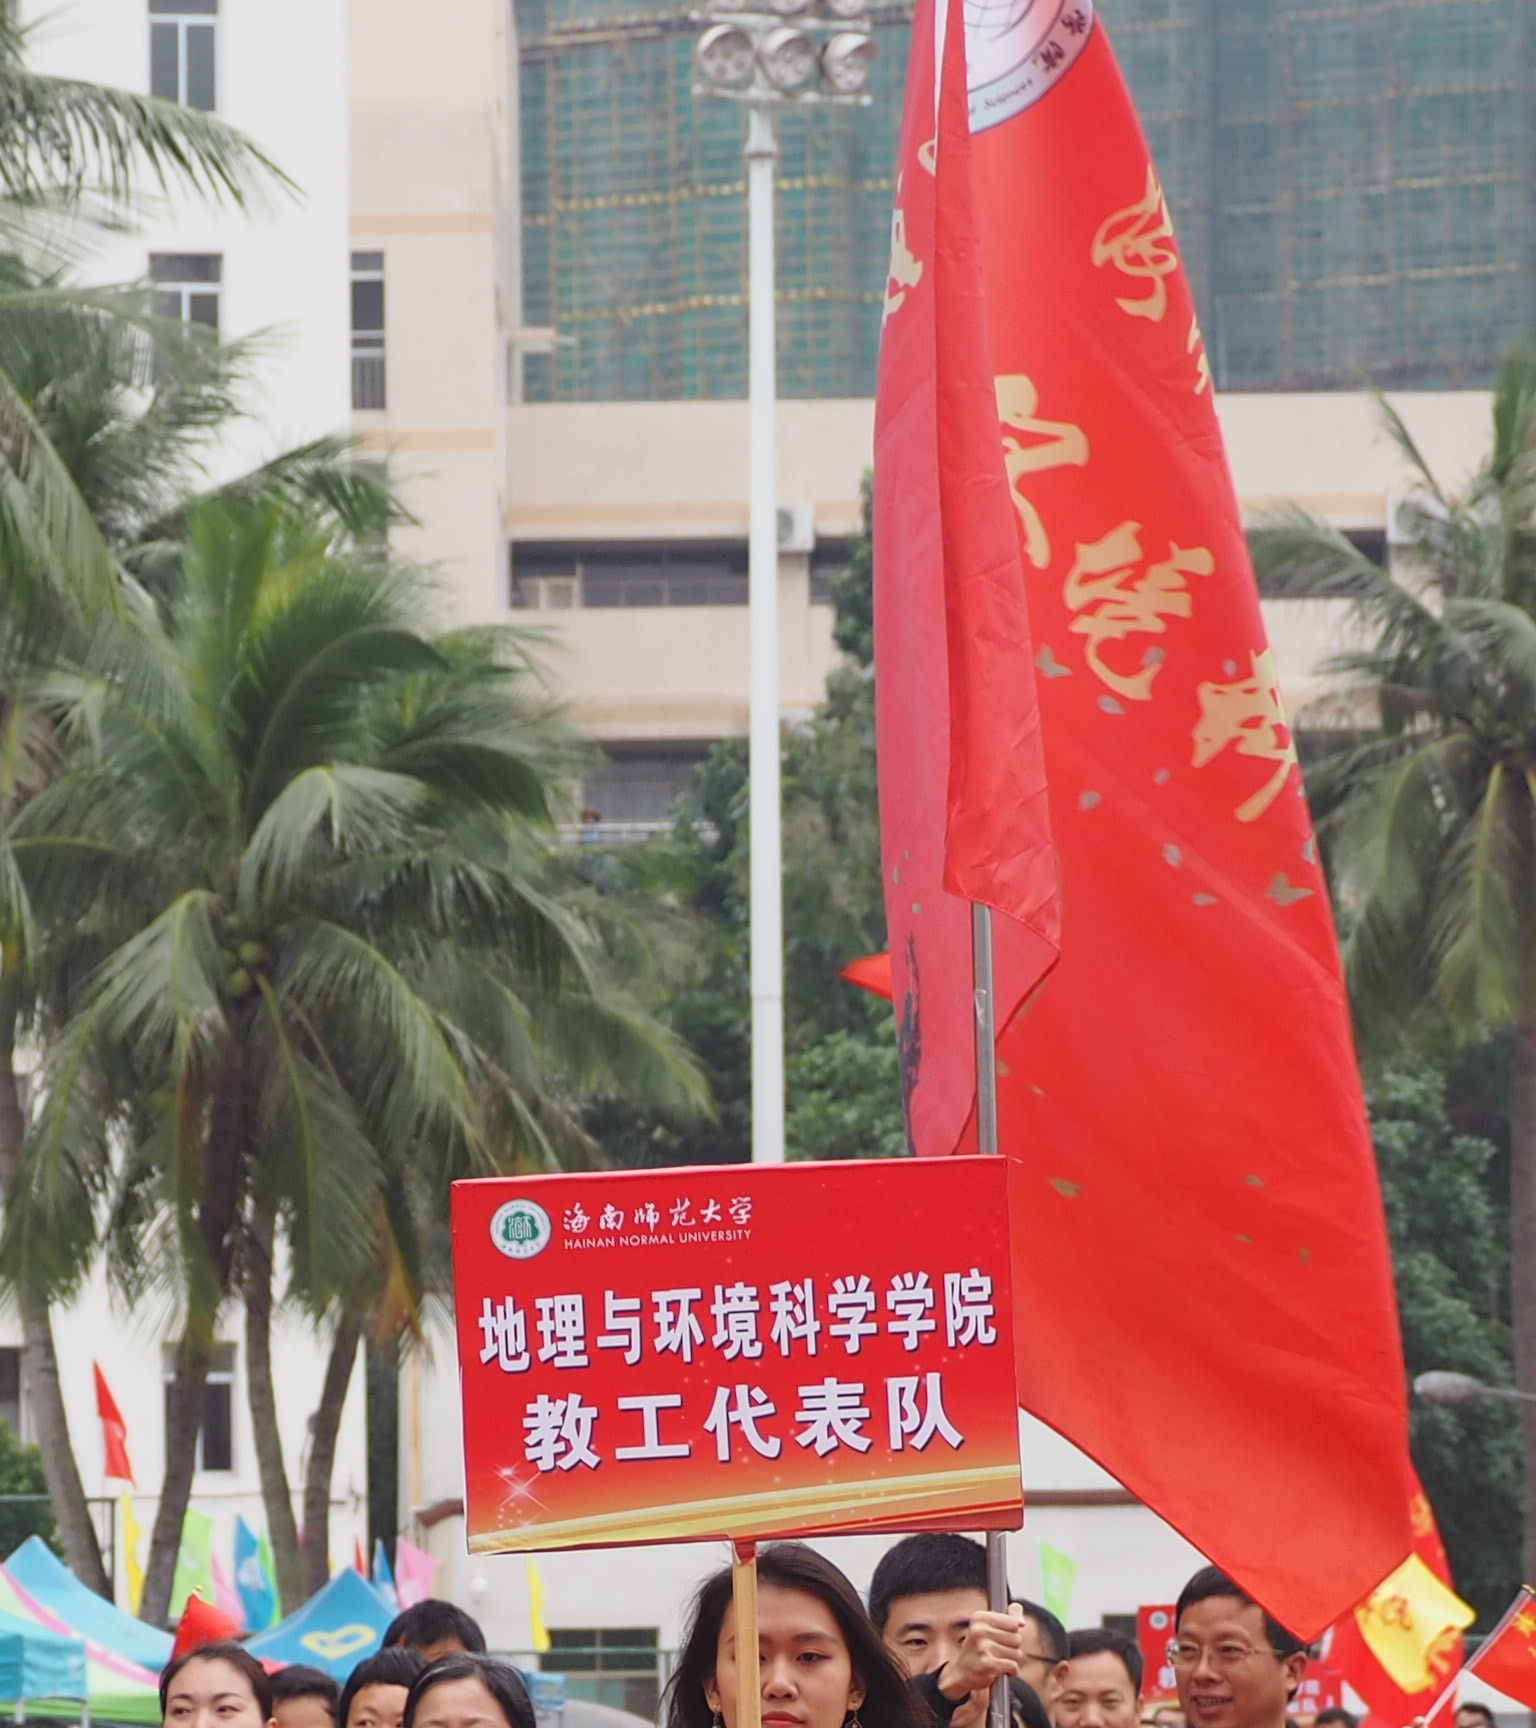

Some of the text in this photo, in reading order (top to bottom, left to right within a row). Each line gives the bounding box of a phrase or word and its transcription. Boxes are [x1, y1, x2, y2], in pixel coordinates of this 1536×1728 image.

[562, 1197, 753, 1233] 海南师范大学
[564, 1229, 752, 1250] HAINAN NORMAL UNIVERSITY
[478, 1267, 997, 1374] 地理与环境科学学院
[522, 1371, 964, 1473] 教工代表队
